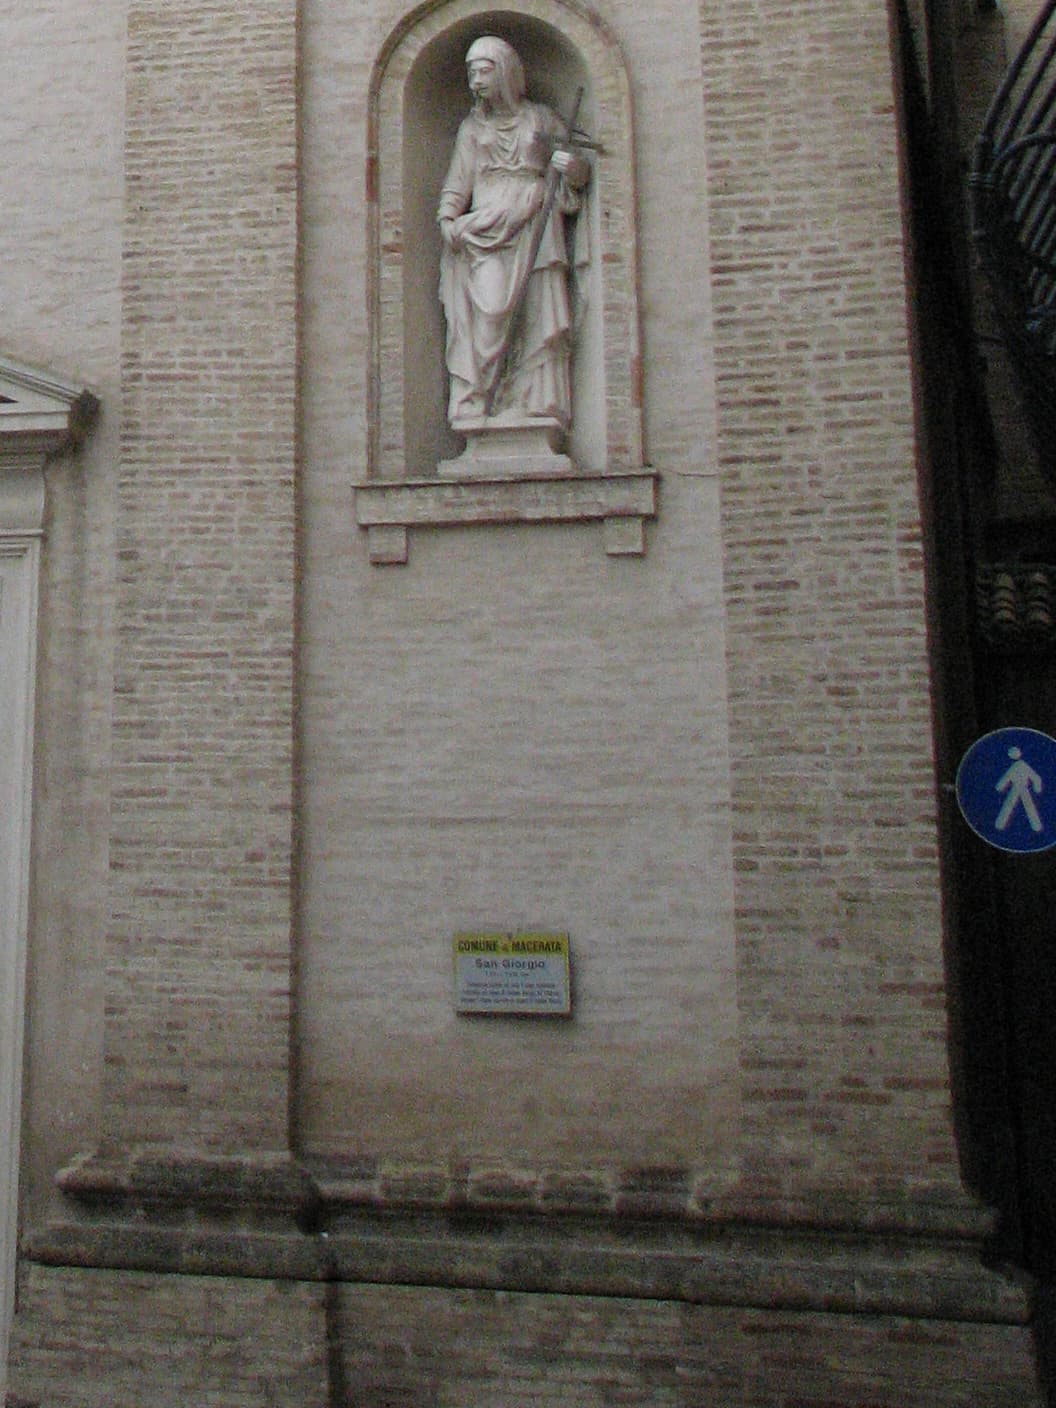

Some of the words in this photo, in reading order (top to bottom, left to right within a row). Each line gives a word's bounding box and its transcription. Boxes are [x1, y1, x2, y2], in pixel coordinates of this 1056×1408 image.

[458, 940, 497, 952] COMUNE
[475, 958, 498, 968] San
[502, 959, 545, 970] Giorgio
